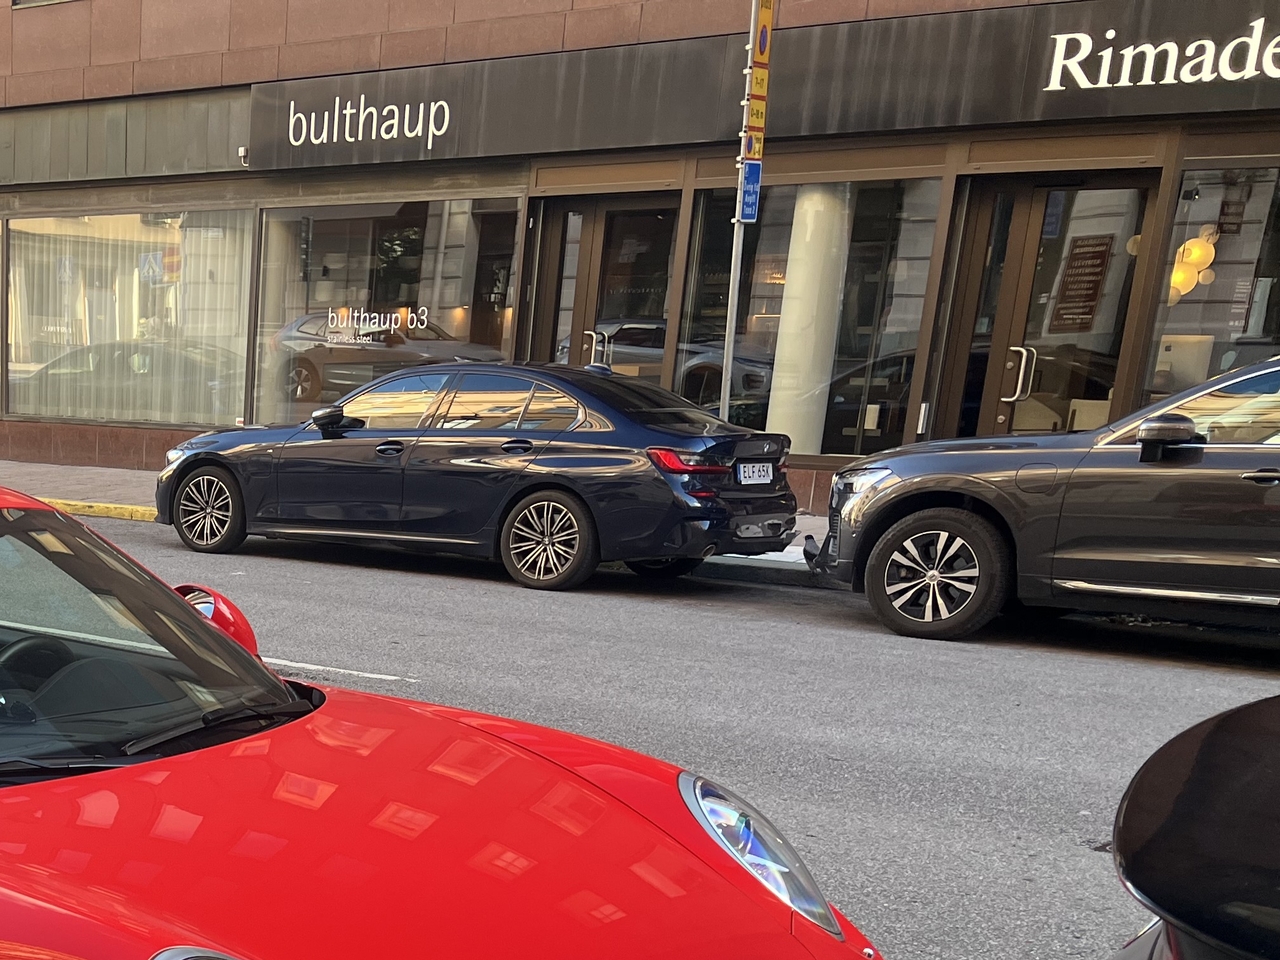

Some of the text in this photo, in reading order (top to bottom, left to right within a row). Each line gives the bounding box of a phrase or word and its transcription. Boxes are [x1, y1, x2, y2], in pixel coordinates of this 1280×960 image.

[288, 94, 450, 149] bulthaup
[327, 306, 428, 335] bulthaup b3
[327, 334, 373, 343] stainless steel
[743, 464, 770, 478] ELF 65K
